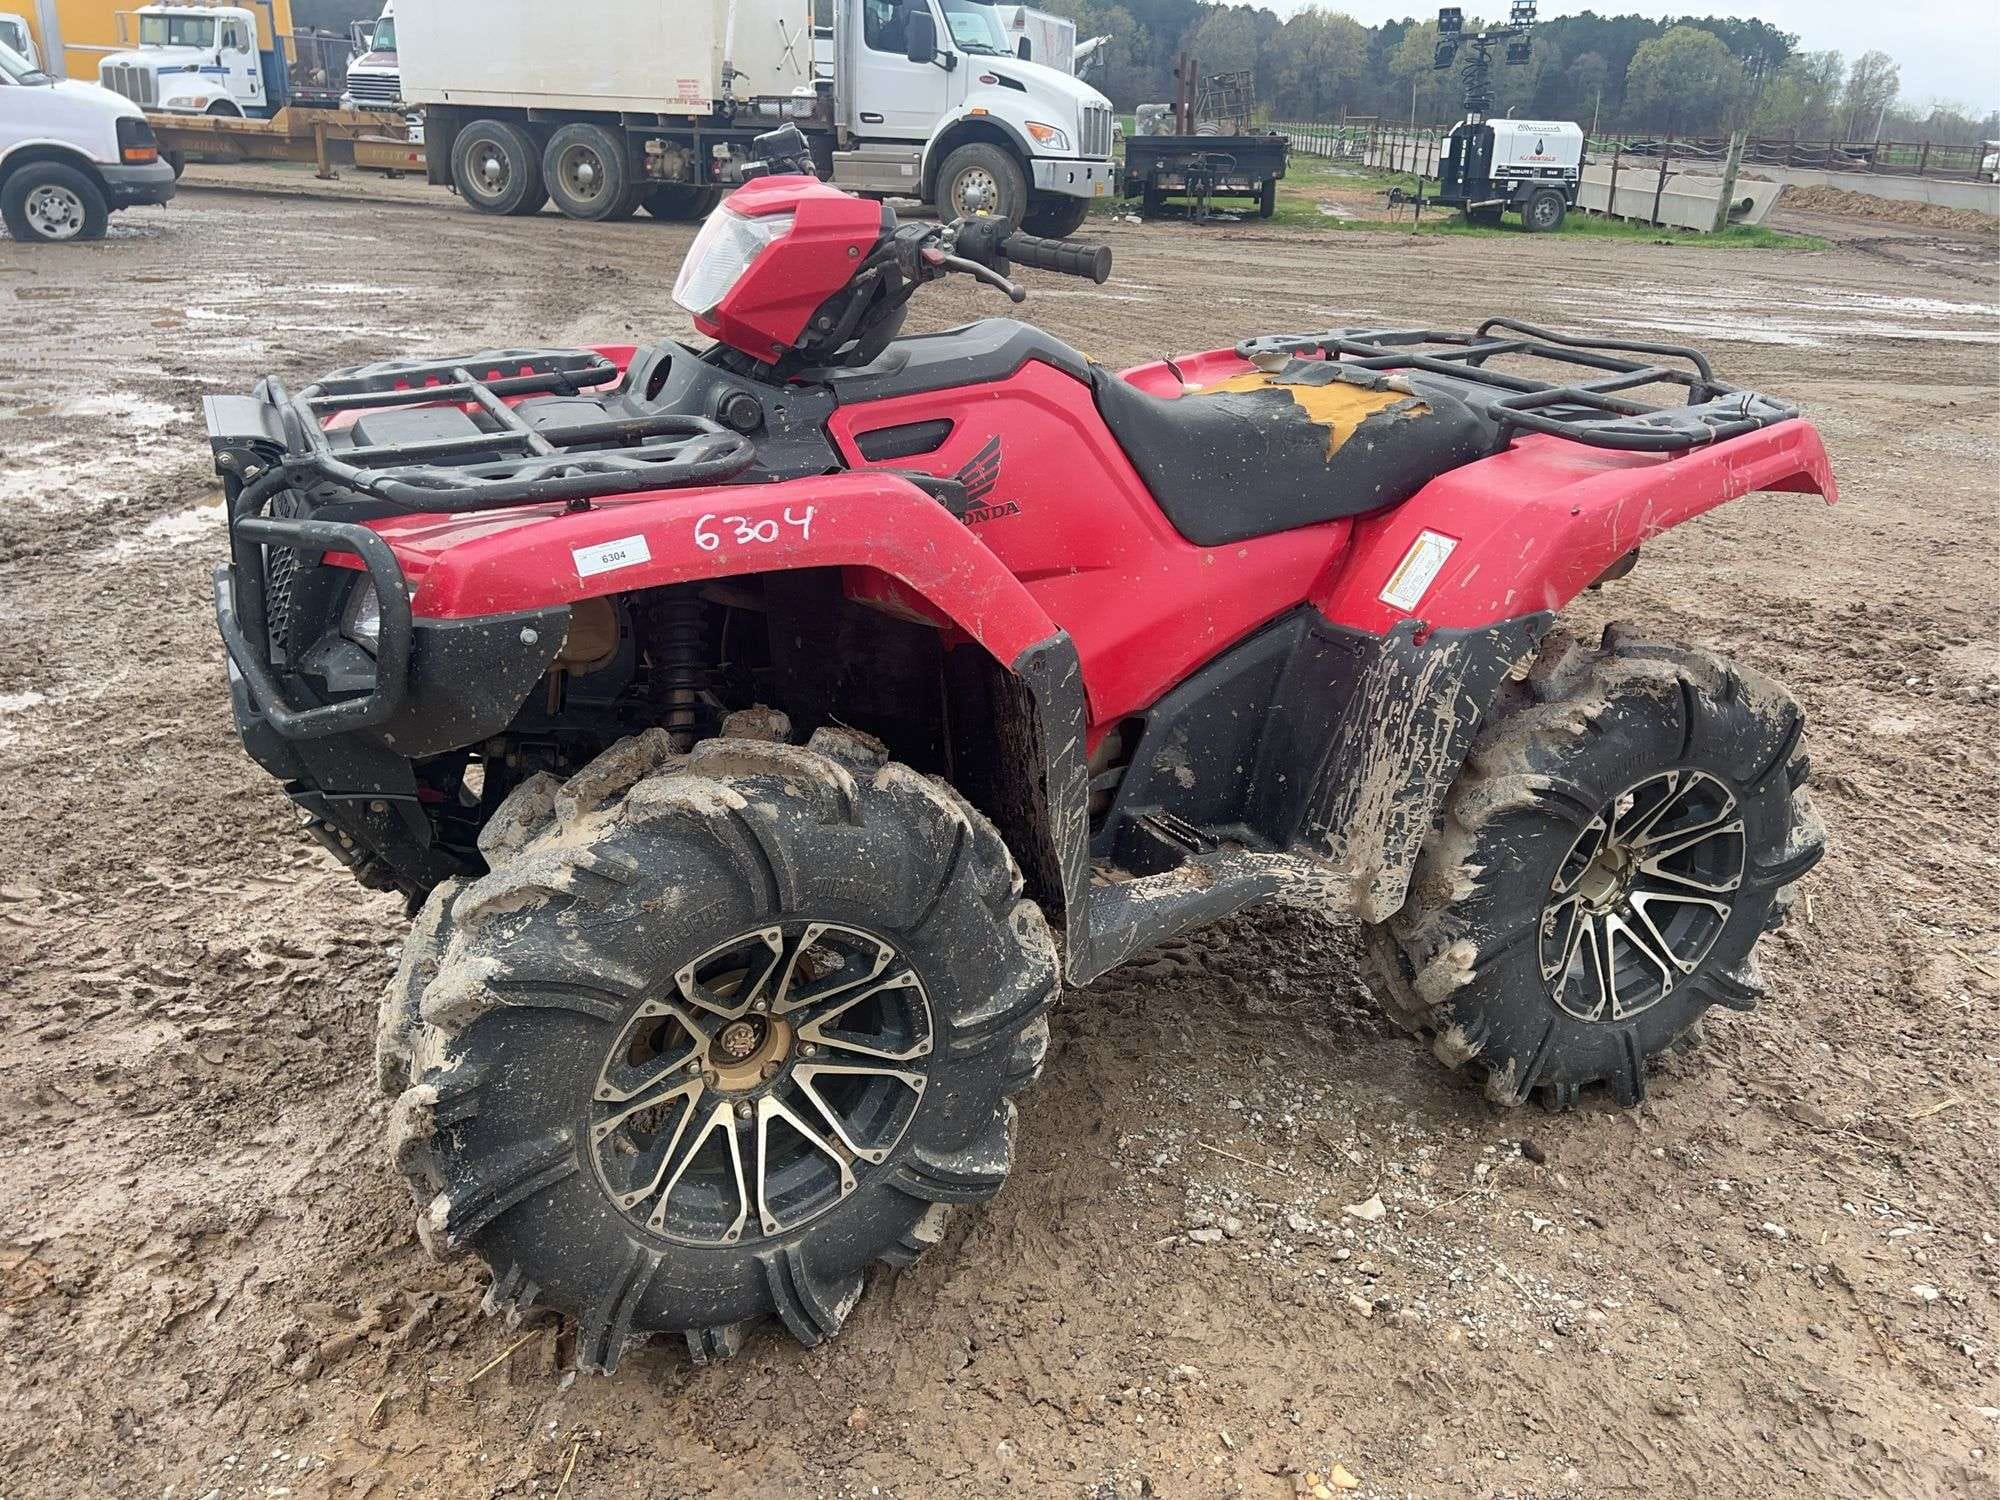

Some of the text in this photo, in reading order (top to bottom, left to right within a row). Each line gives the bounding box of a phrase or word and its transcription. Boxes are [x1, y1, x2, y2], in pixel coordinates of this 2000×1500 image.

[960, 501, 1020, 526] ONDA
[694, 505, 815, 551] 6304
[601, 550, 626, 564] 6304
